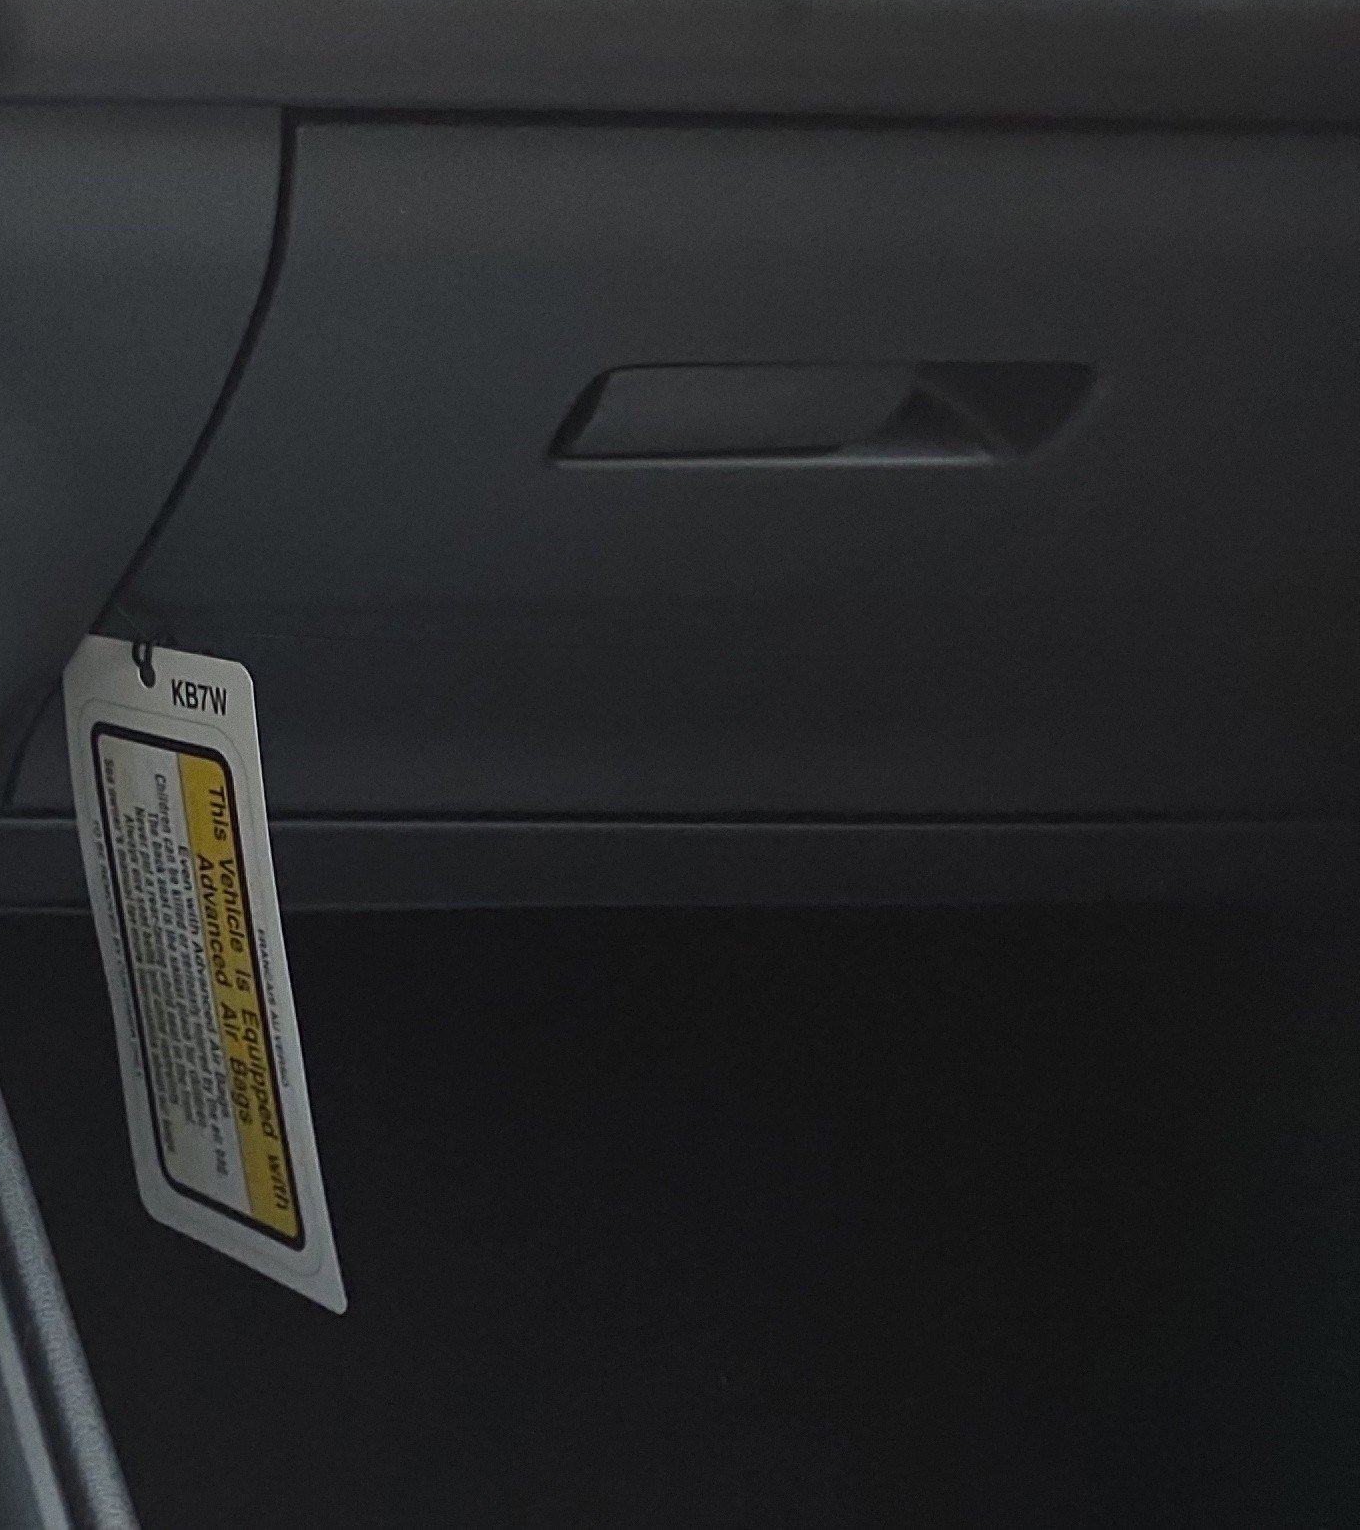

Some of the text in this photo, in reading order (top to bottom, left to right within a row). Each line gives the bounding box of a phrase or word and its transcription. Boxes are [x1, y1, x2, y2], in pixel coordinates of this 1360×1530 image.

[171, 678, 227, 716] KB7W
[206, 784, 231, 842] This
[197, 853, 232, 988] Advanced
[217, 856, 247, 954] Vehicle
[219, 1000, 242, 1044] Air
[224, 1054, 255, 1128] Bags
[238, 1007, 278, 1141] Equipped
